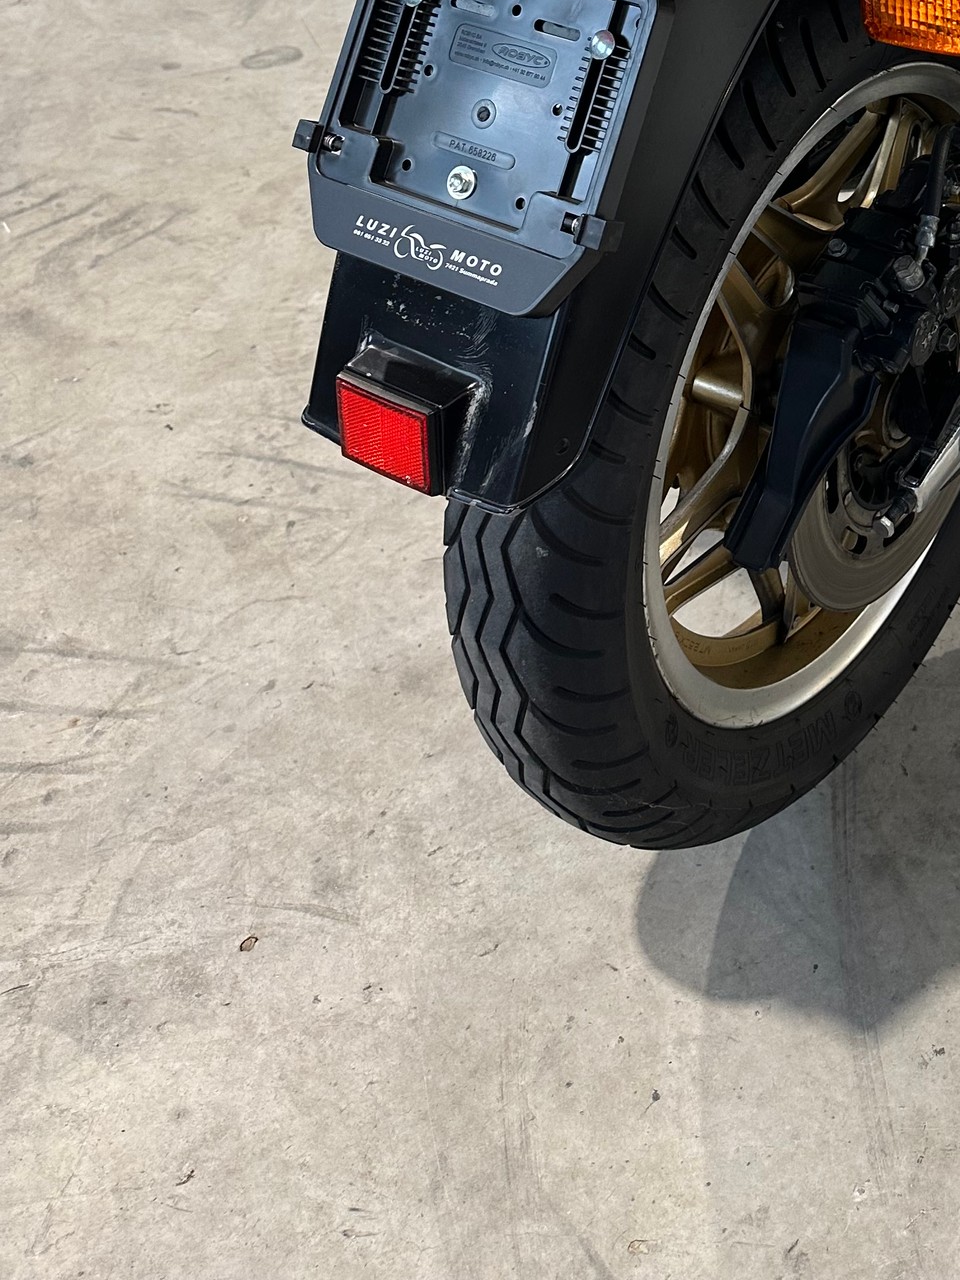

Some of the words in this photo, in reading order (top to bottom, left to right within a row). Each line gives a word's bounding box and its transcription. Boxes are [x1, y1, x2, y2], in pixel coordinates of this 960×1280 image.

[355, 215, 398, 238] LUZI
[415, 246, 432, 256] LUZI
[418, 253, 438, 264] MOTO
[450, 249, 503, 276] MOTO
